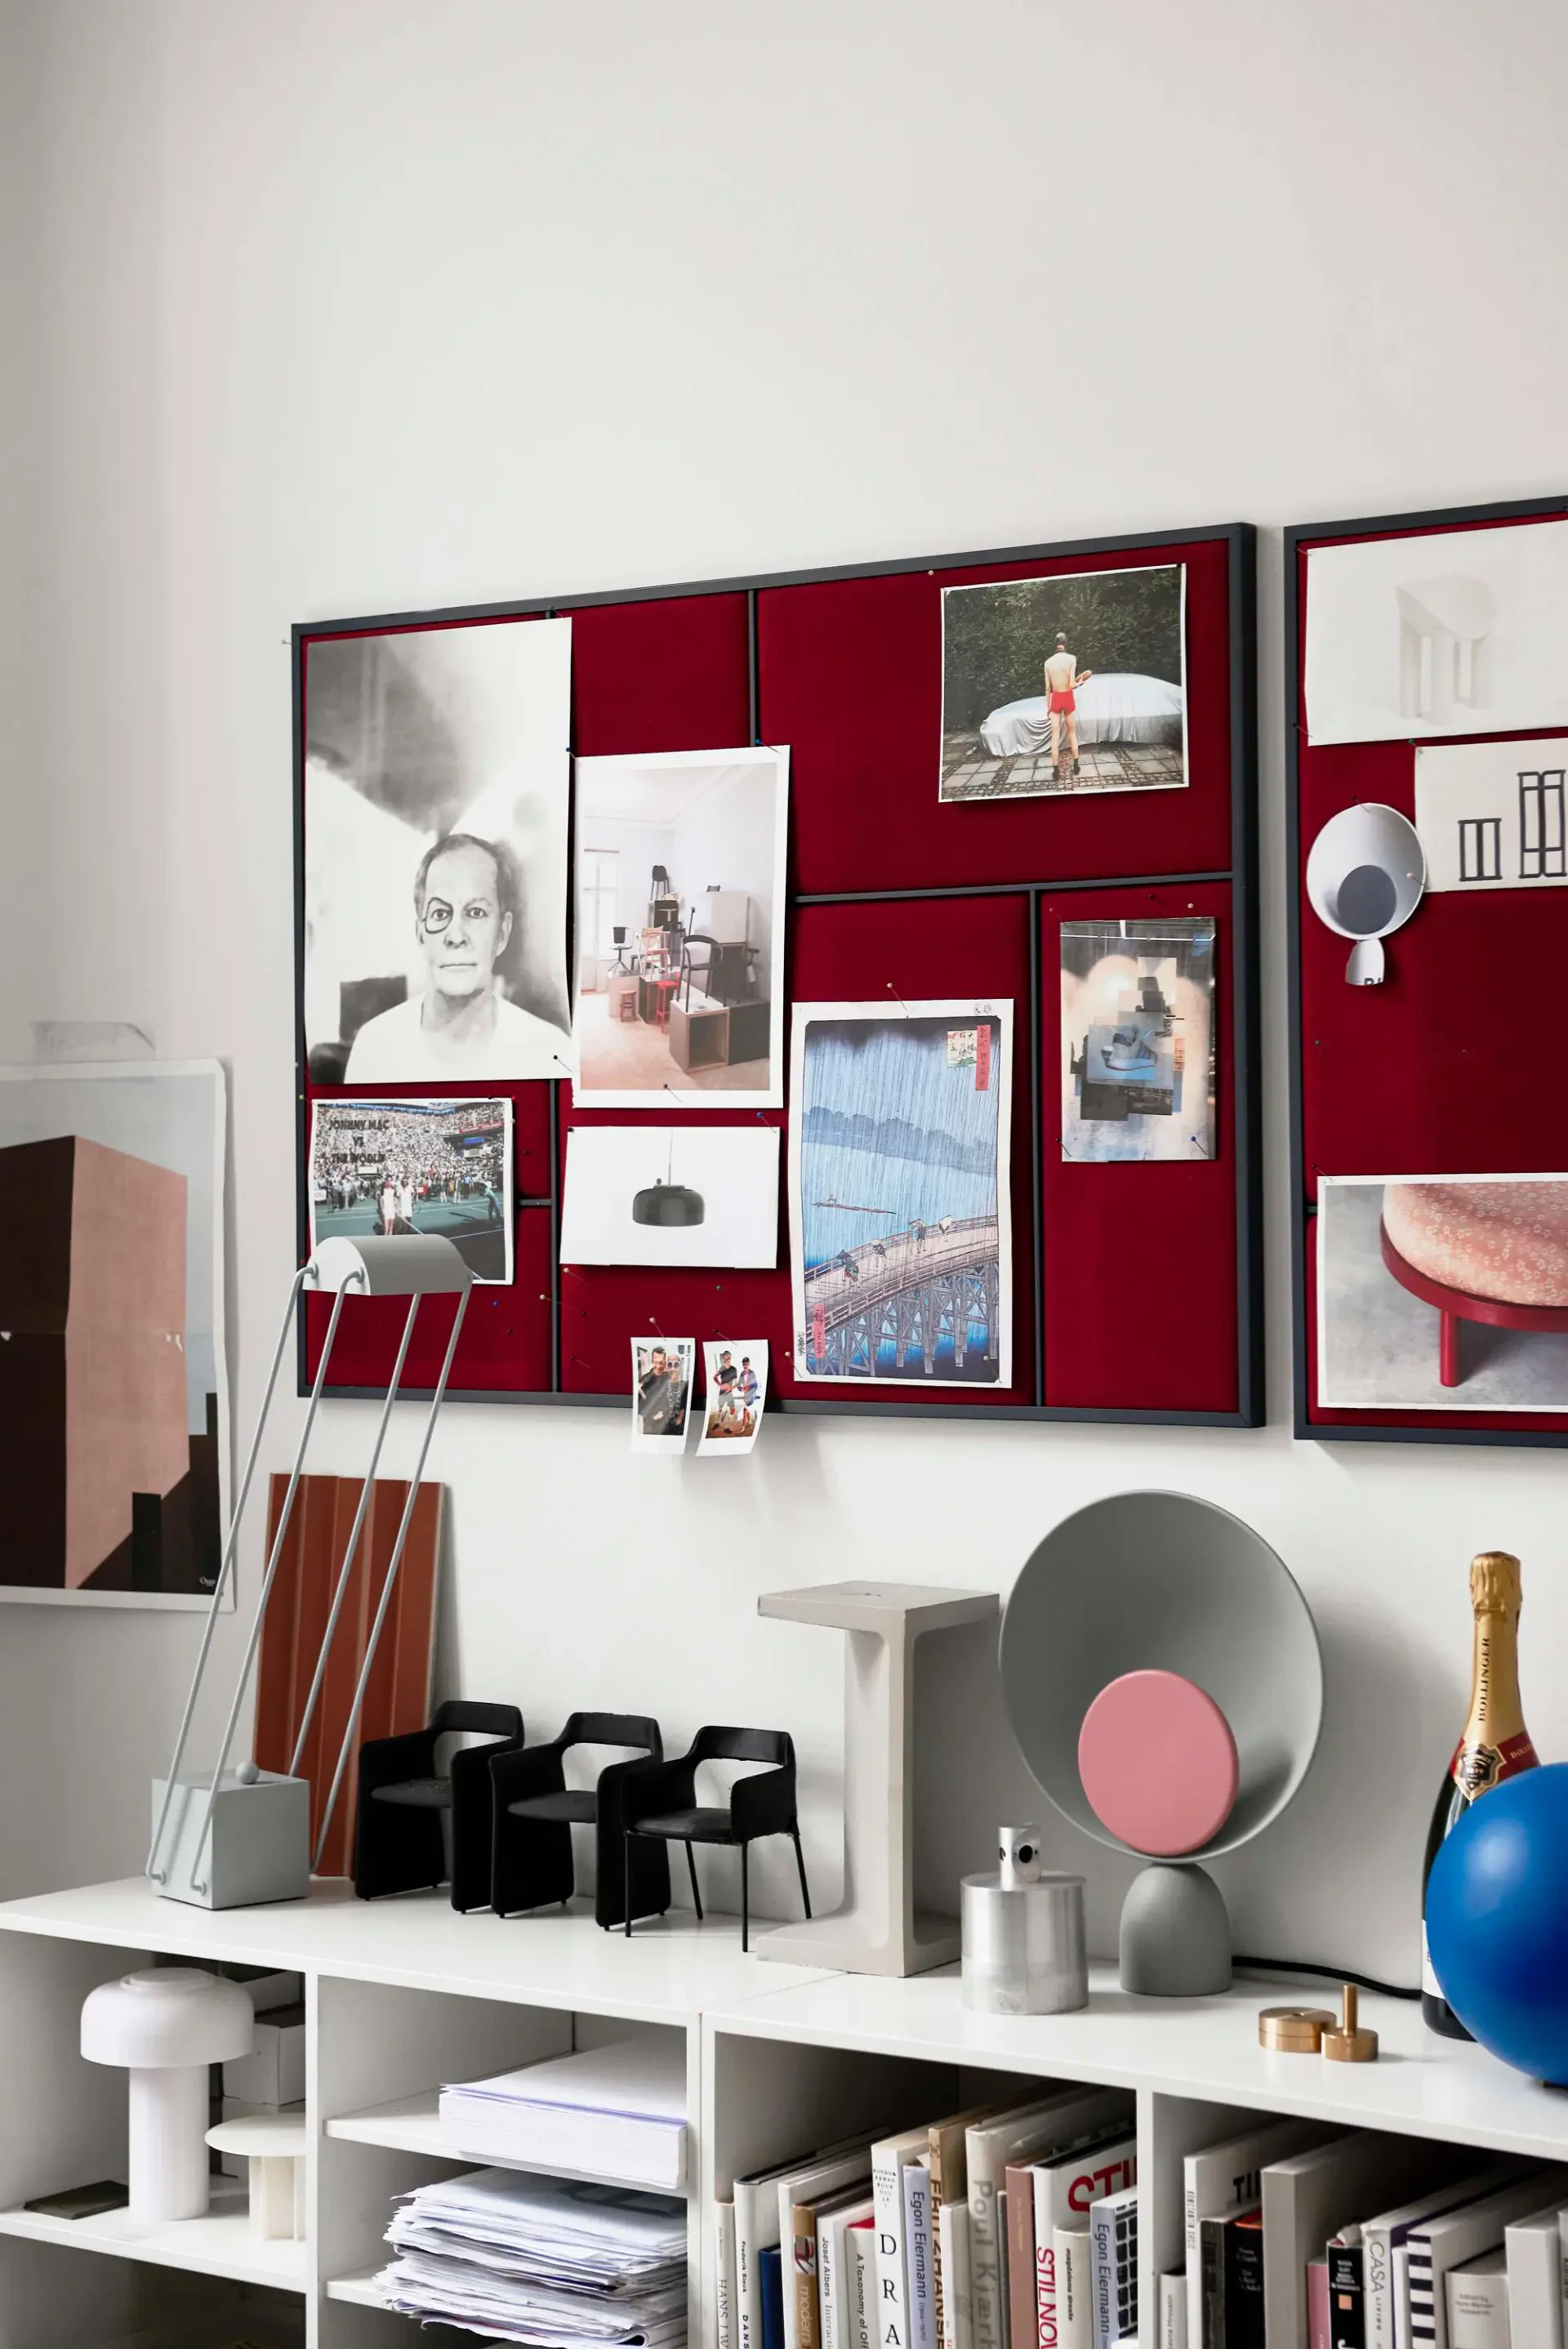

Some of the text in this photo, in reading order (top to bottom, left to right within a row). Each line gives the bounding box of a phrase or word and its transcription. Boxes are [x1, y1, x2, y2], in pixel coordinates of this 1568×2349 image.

[328, 1120, 390, 1130] JOHNNY MAC
[353, 1136, 364, 1147] VS
[332, 1152, 385, 1164] THE WORLD
[1478, 1637, 1490, 1721] BOLLINGER
[911, 2191, 924, 2227] Egon
[973, 2180, 995, 2246] Poul
[856, 2253, 863, 2262] A
[1095, 2223, 1109, 2261] Egon
[915, 2233, 927, 2298] Eiermann
[1370, 2241, 1386, 2293] CASA
[718, 2279, 728, 2319] HANS
[857, 2265, 867, 2316] Taxonomy
[1098, 2266, 1111, 2333] Eiermann
[800, 2286, 813, 2342] modern
[860, 2319, 868, 2330] of
